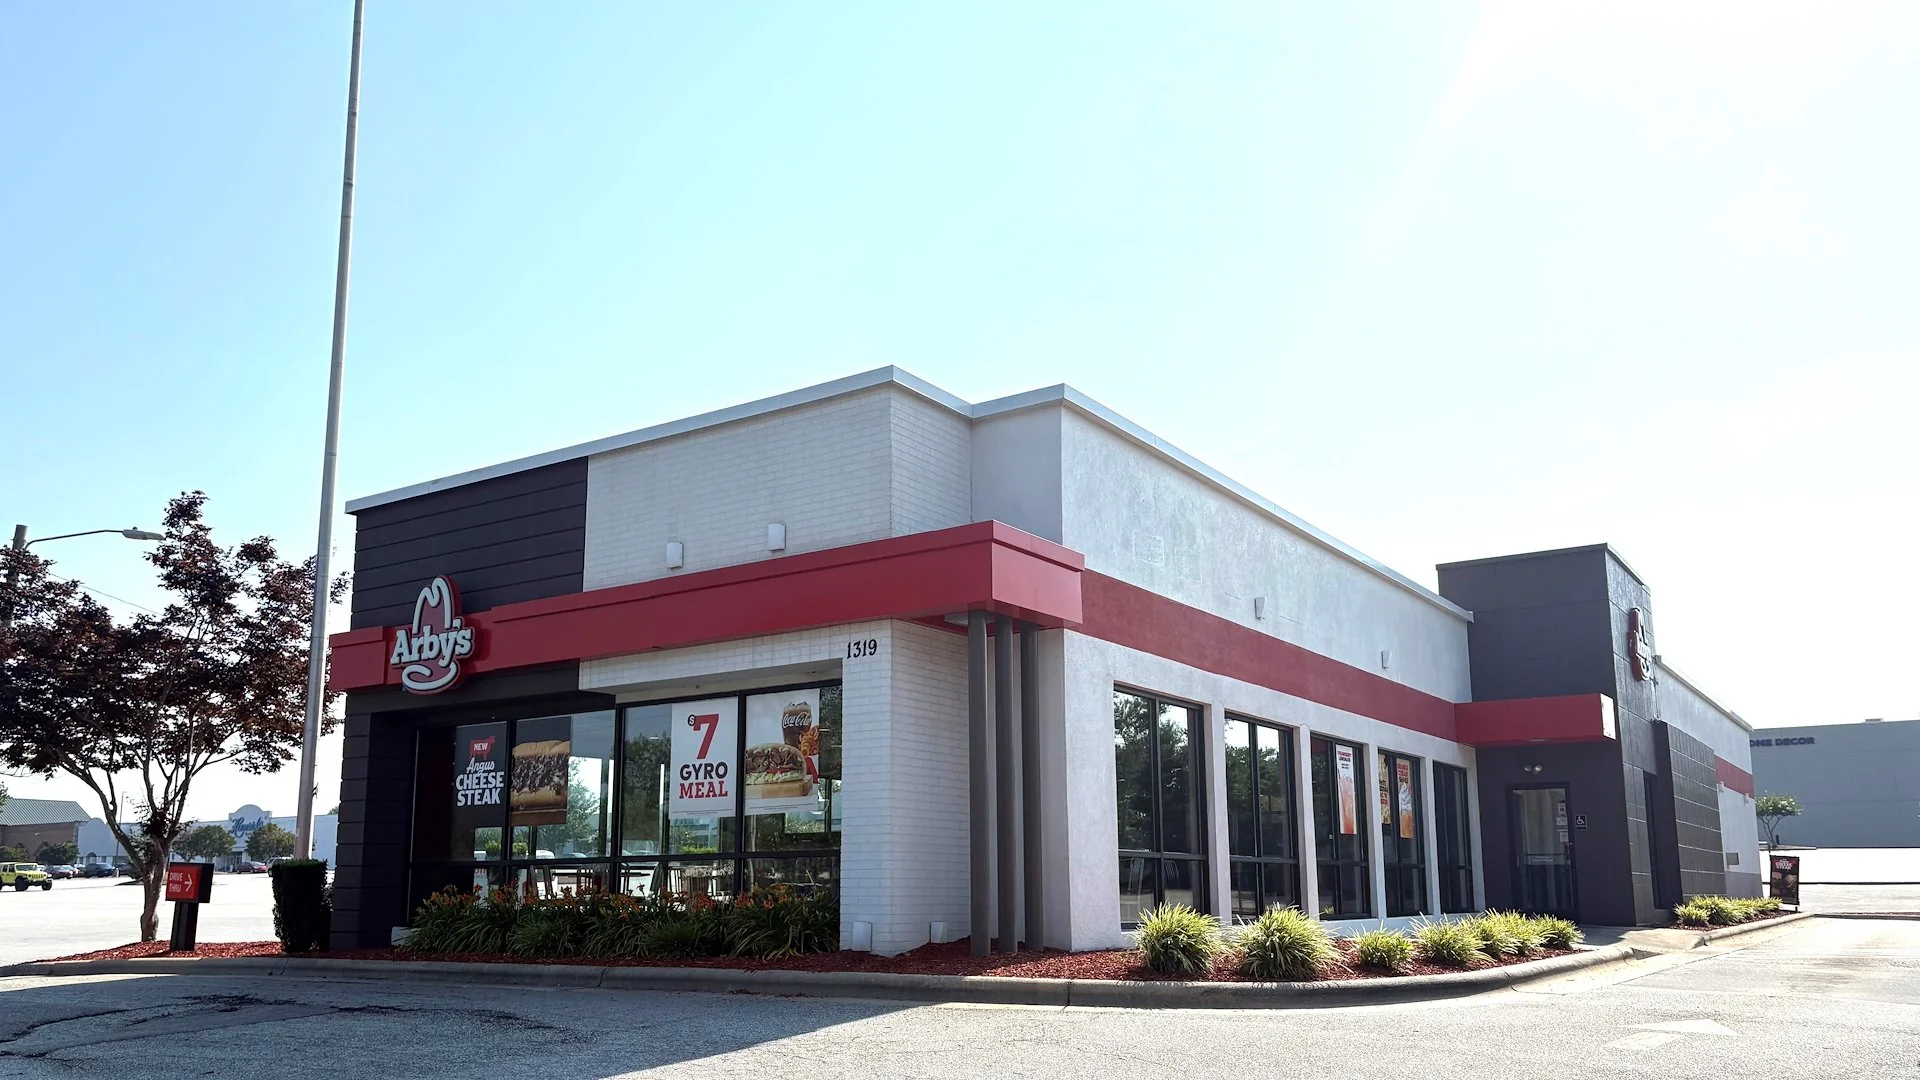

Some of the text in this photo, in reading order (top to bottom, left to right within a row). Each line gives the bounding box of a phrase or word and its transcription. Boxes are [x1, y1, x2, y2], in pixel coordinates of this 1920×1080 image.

[390, 618, 473, 668] Arby's
[846, 639, 878, 660] 1319
[473, 742, 489, 751] NEW
[1750, 736, 1815, 748] OME DECOR
[466, 757, 495, 777] Angus
[679, 761, 728, 781] GYRO
[455, 771, 505, 790] CHEESE
[679, 780, 728, 799] MEAL
[457, 788, 501, 807] STEAK
[169, 872, 183, 881] DRIVE
[168, 883, 182, 892] THRU
